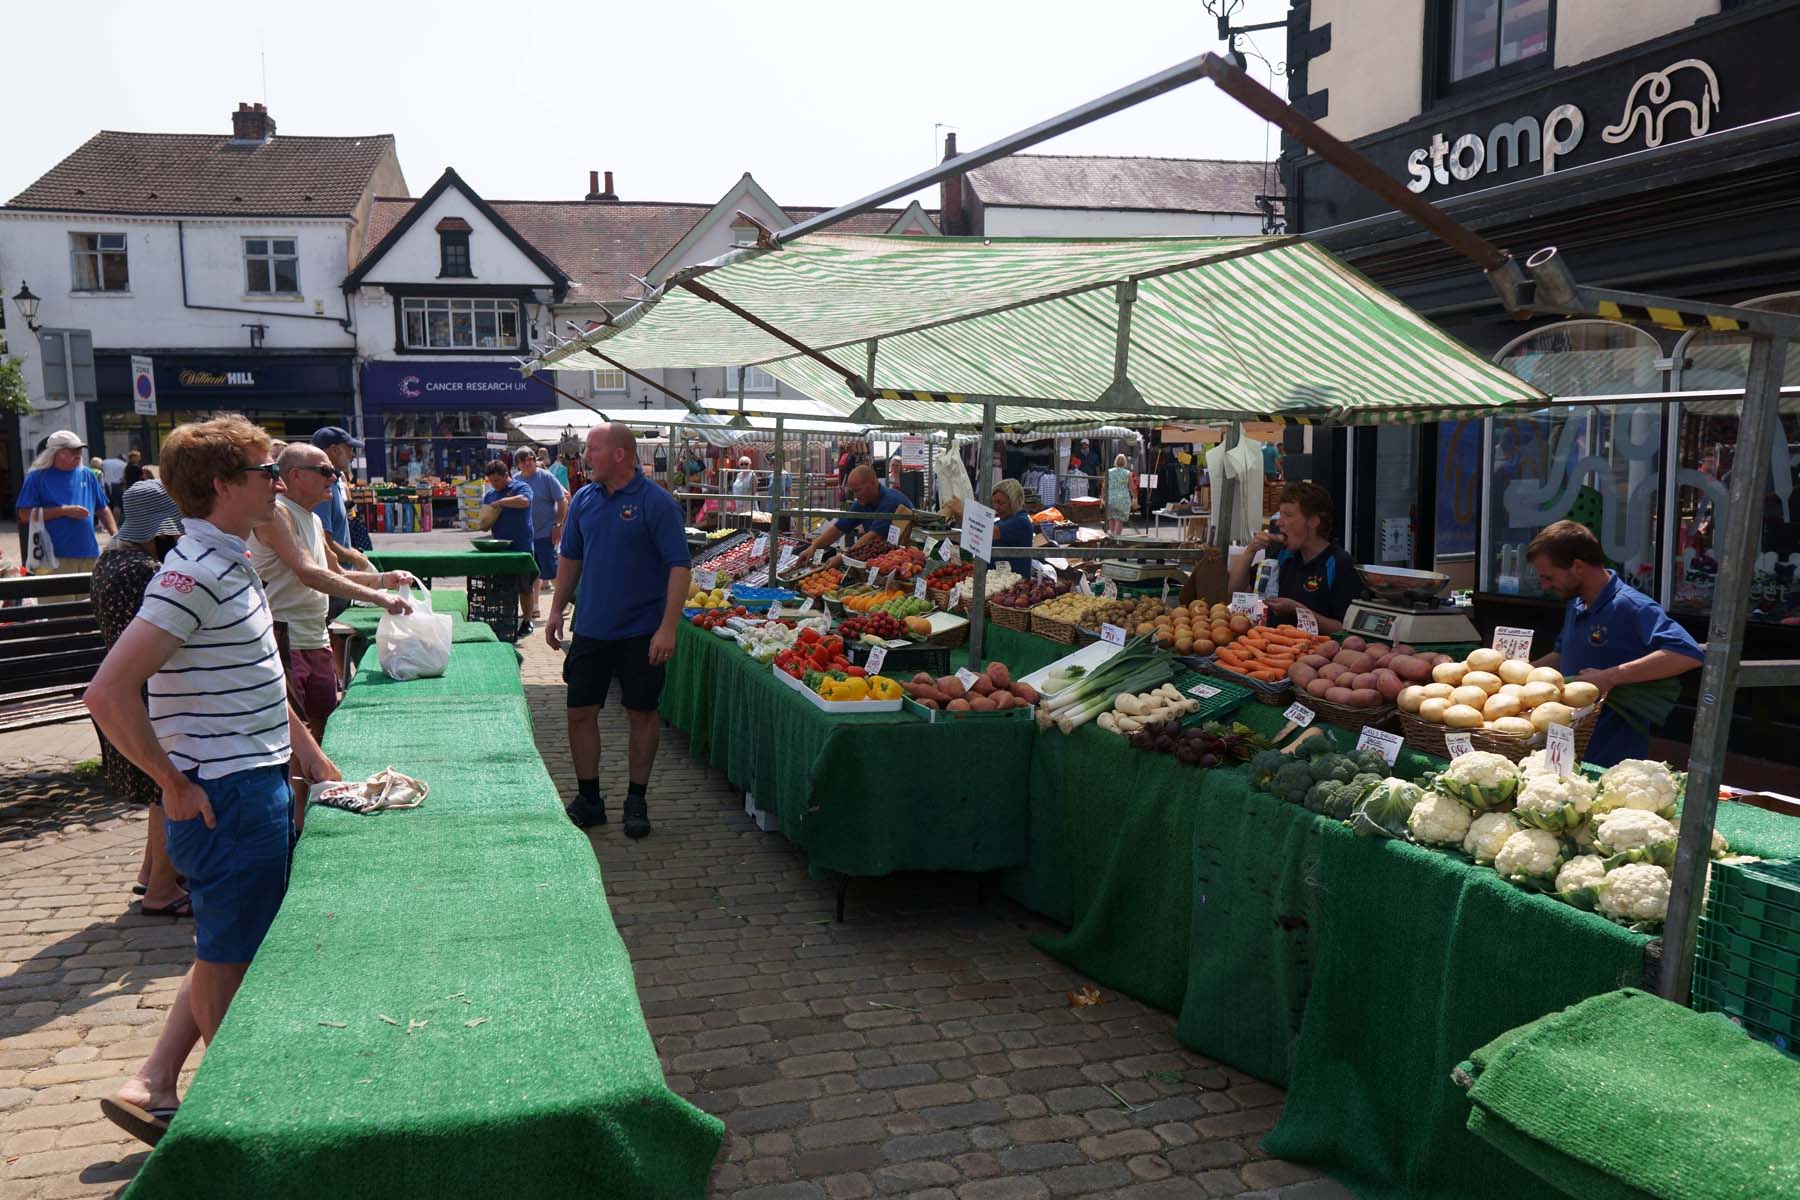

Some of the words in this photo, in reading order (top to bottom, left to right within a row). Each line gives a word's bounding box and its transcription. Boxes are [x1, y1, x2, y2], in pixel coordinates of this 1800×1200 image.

[1406, 104, 1585, 194] stomp
[180, 370, 226, 385] William
[227, 372, 255, 385] HILL
[425, 382, 463, 391] CANCER
[466, 382, 512, 391] RESEARCH
[514, 382, 528, 391] UK
